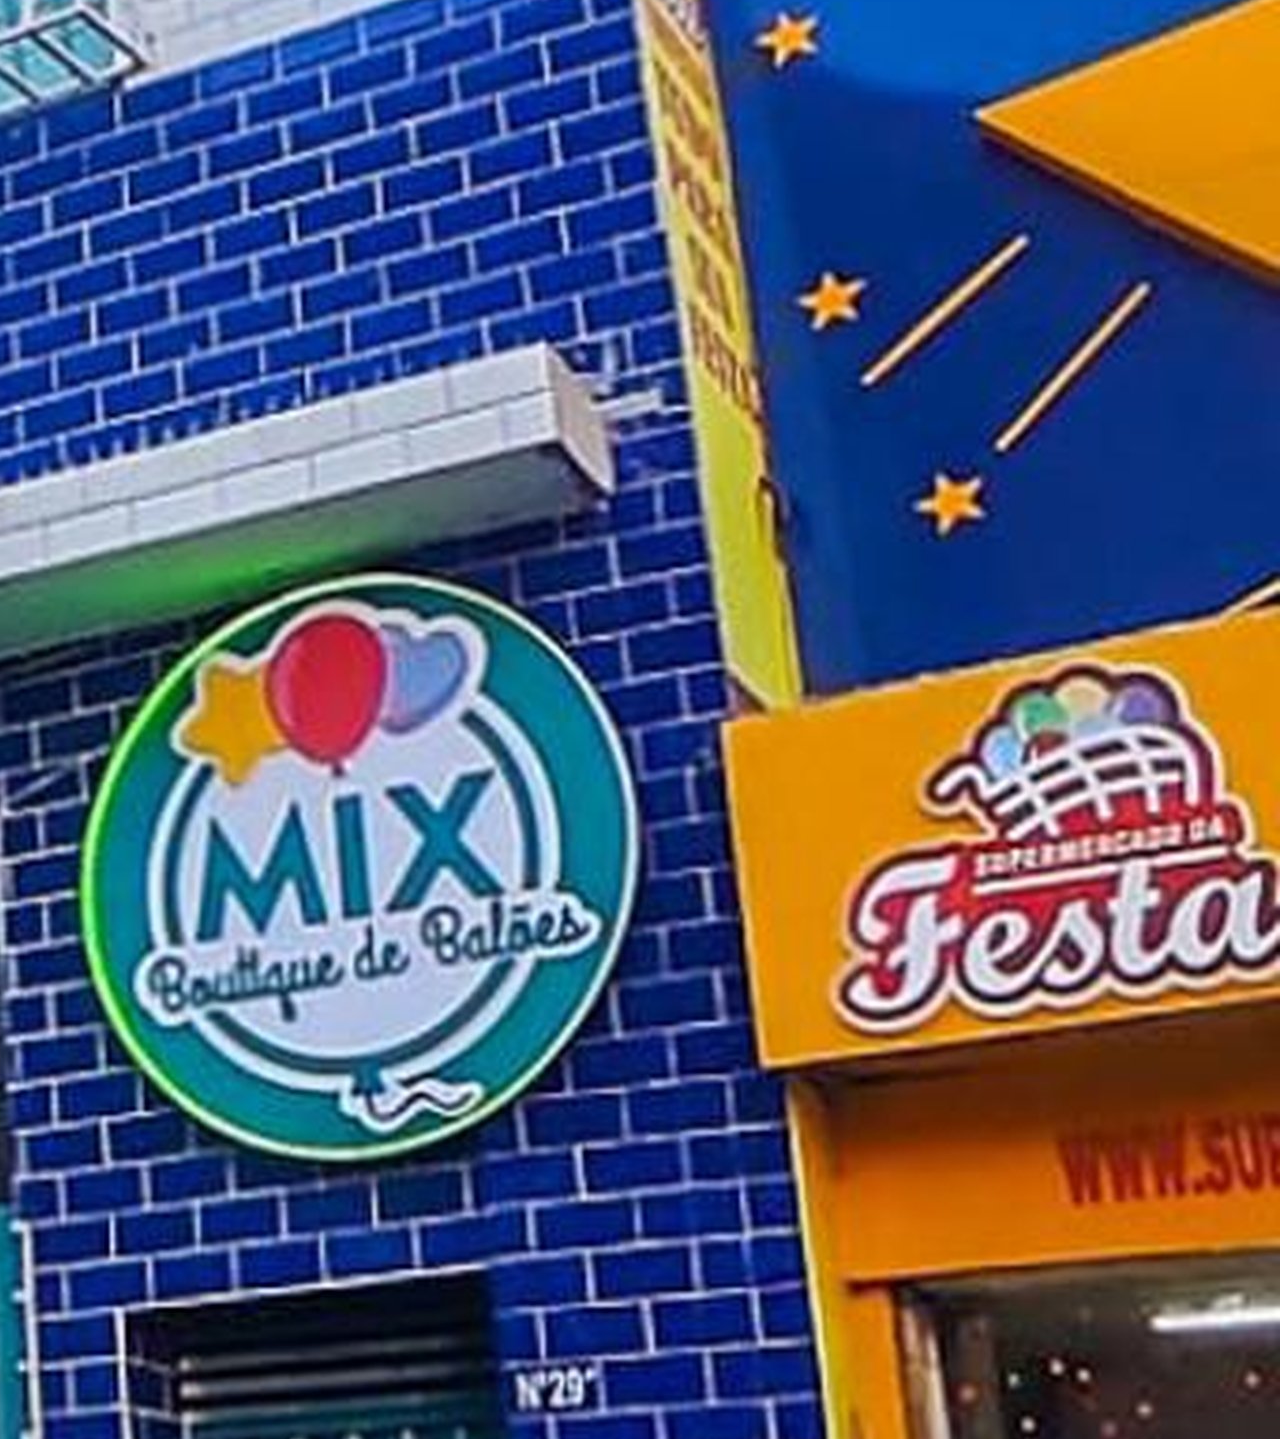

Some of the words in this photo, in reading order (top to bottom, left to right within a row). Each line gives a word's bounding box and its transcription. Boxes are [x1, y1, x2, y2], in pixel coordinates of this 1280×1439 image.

[196, 770, 505, 944] MIX
[845, 852, 1280, 1012] Festa
[147, 955, 342, 1023] Boutique
[354, 928, 410, 980] de
[420, 902, 590, 966] Balões
